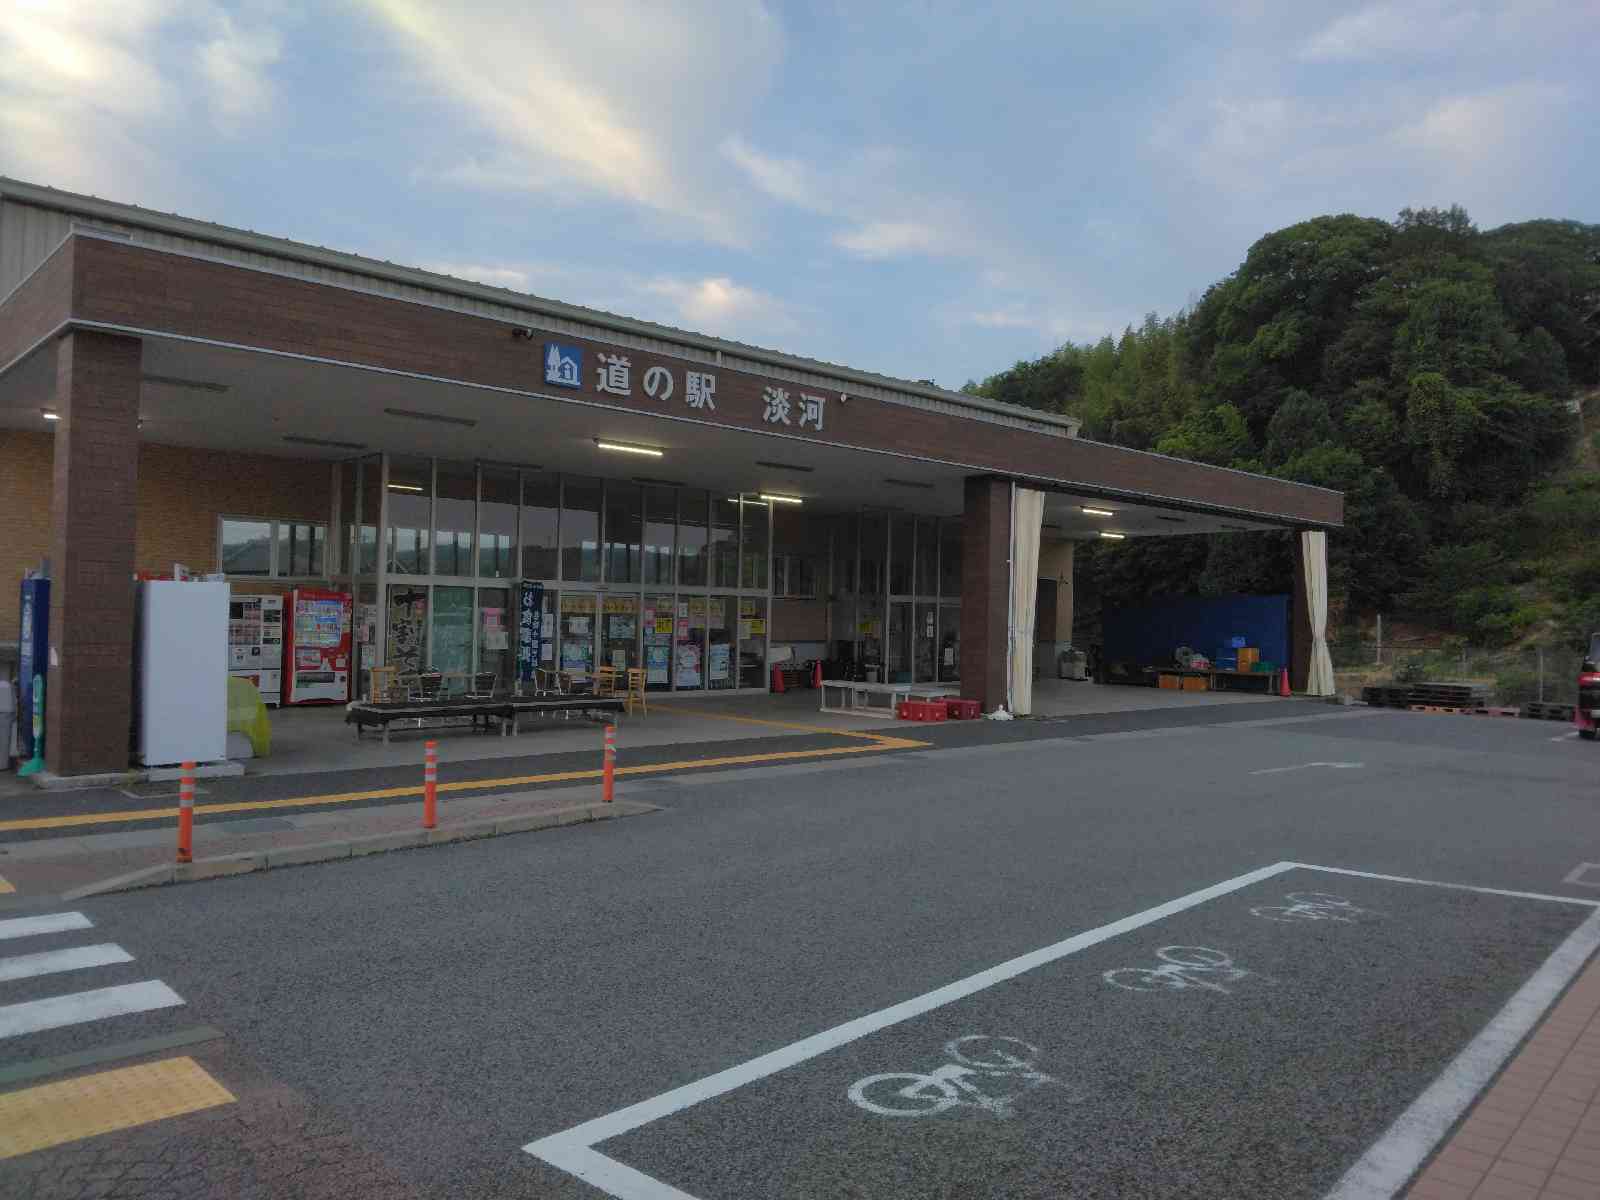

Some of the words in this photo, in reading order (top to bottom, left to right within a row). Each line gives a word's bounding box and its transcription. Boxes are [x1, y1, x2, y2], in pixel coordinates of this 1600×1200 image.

[596, 353, 716, 410] 道の駅
[762, 387, 826, 430] 淡河
